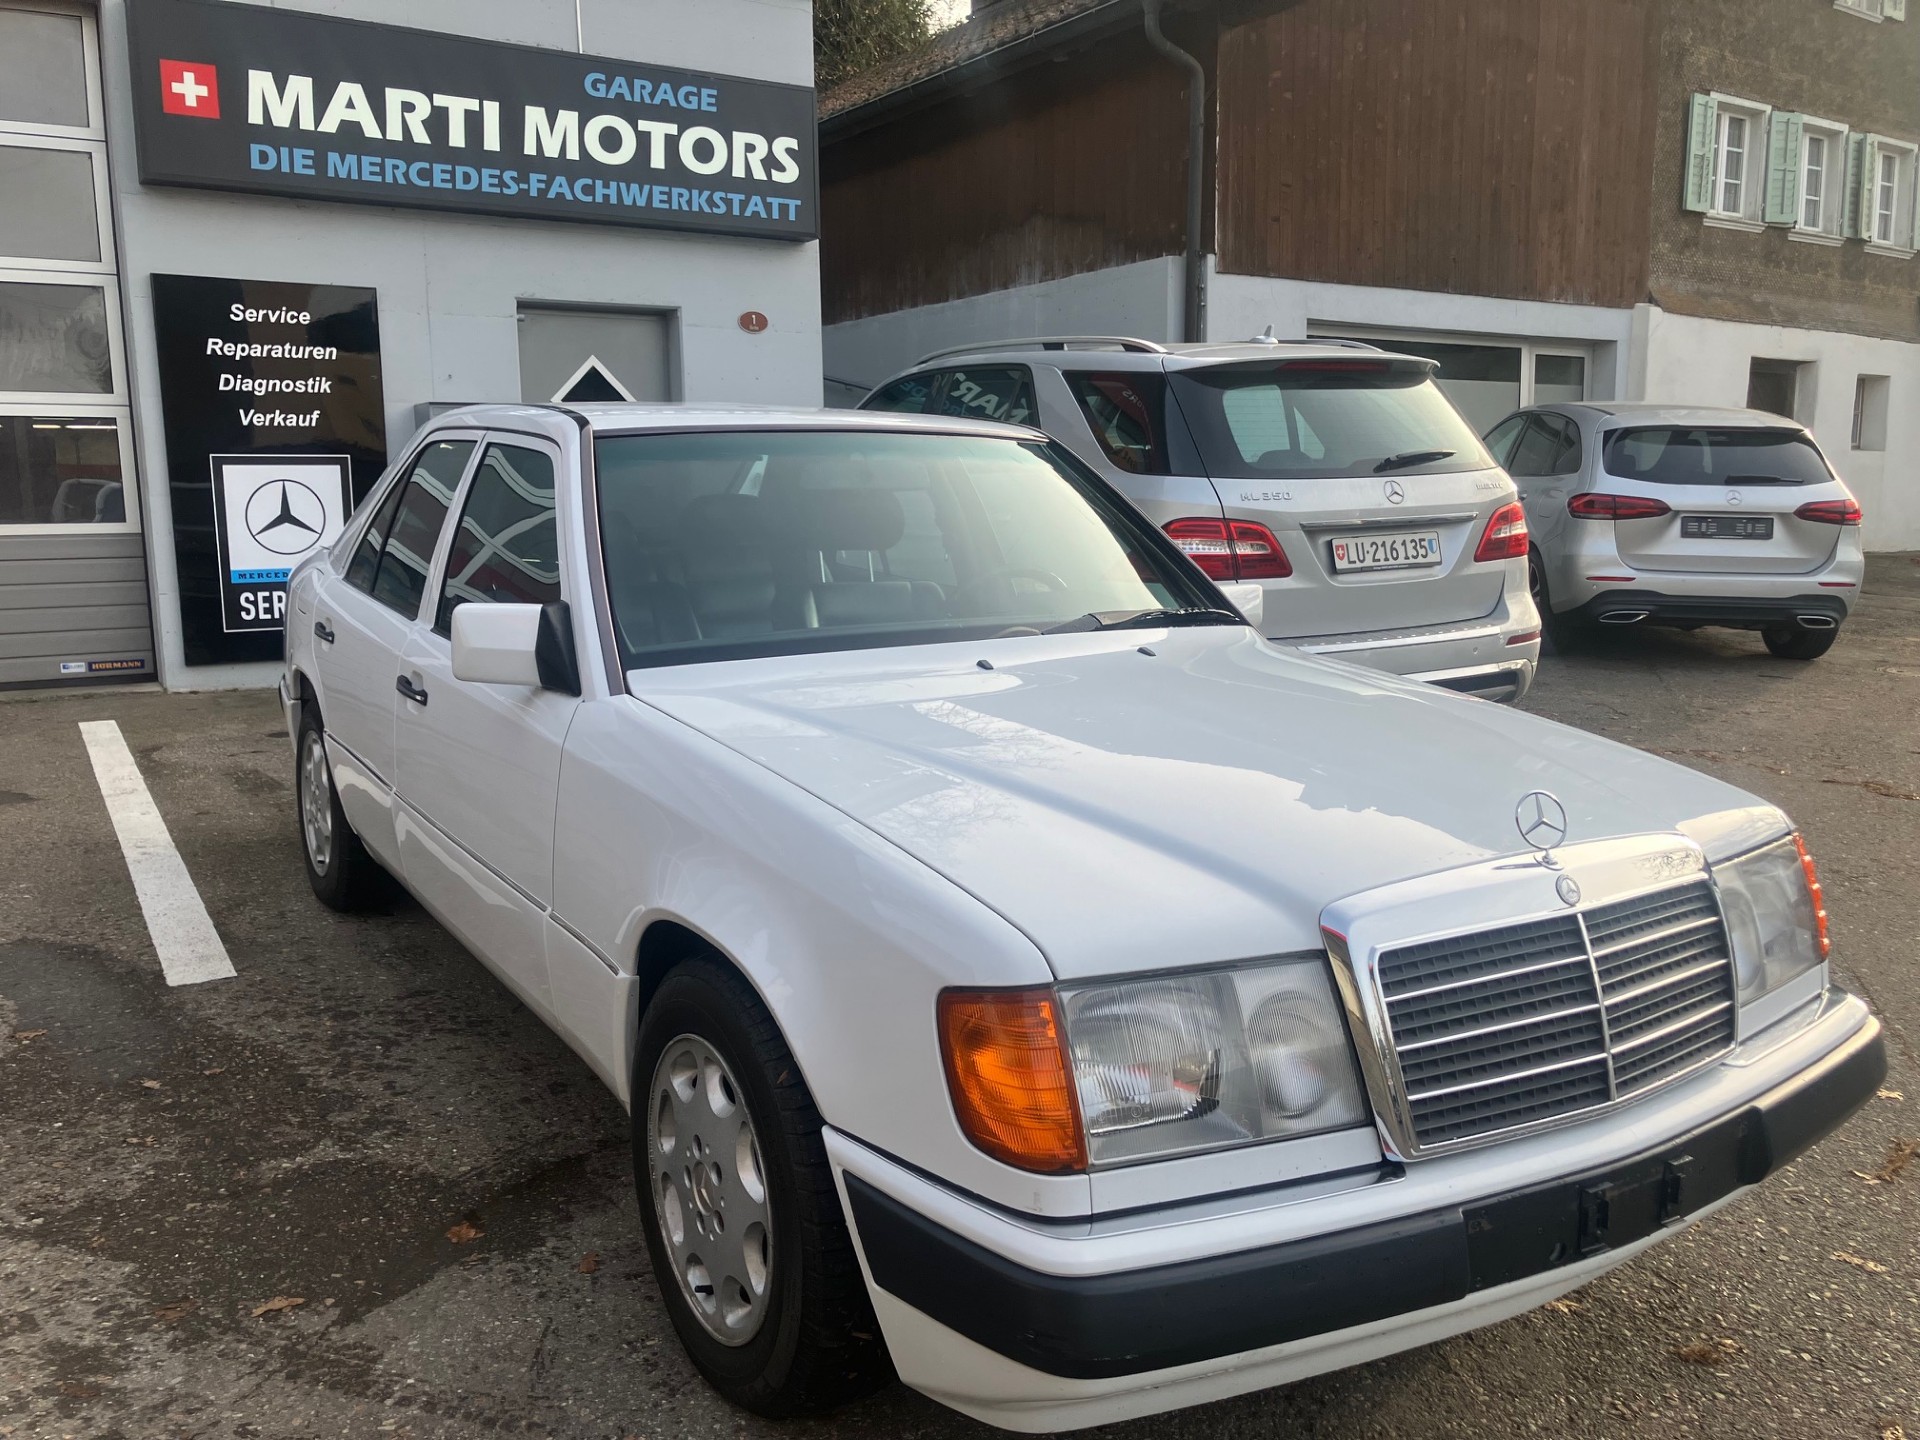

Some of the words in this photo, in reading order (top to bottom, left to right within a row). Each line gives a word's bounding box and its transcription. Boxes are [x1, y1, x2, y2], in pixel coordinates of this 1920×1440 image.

[585, 72, 718, 112] GARAGE
[247, 69, 501, 152] MARTI
[523, 106, 800, 184] MOTORS
[250, 143, 315, 175] DIE
[326, 152, 802, 222] MERCEDES-FACHWERKSTATT
[229, 303, 311, 324] Service
[206, 337, 337, 361] Reparaturen
[218, 373, 332, 395] Diagnostik
[238, 408, 321, 427] Verkauf
[238, 571, 289, 579] MERCED
[240, 590, 287, 621] SER
